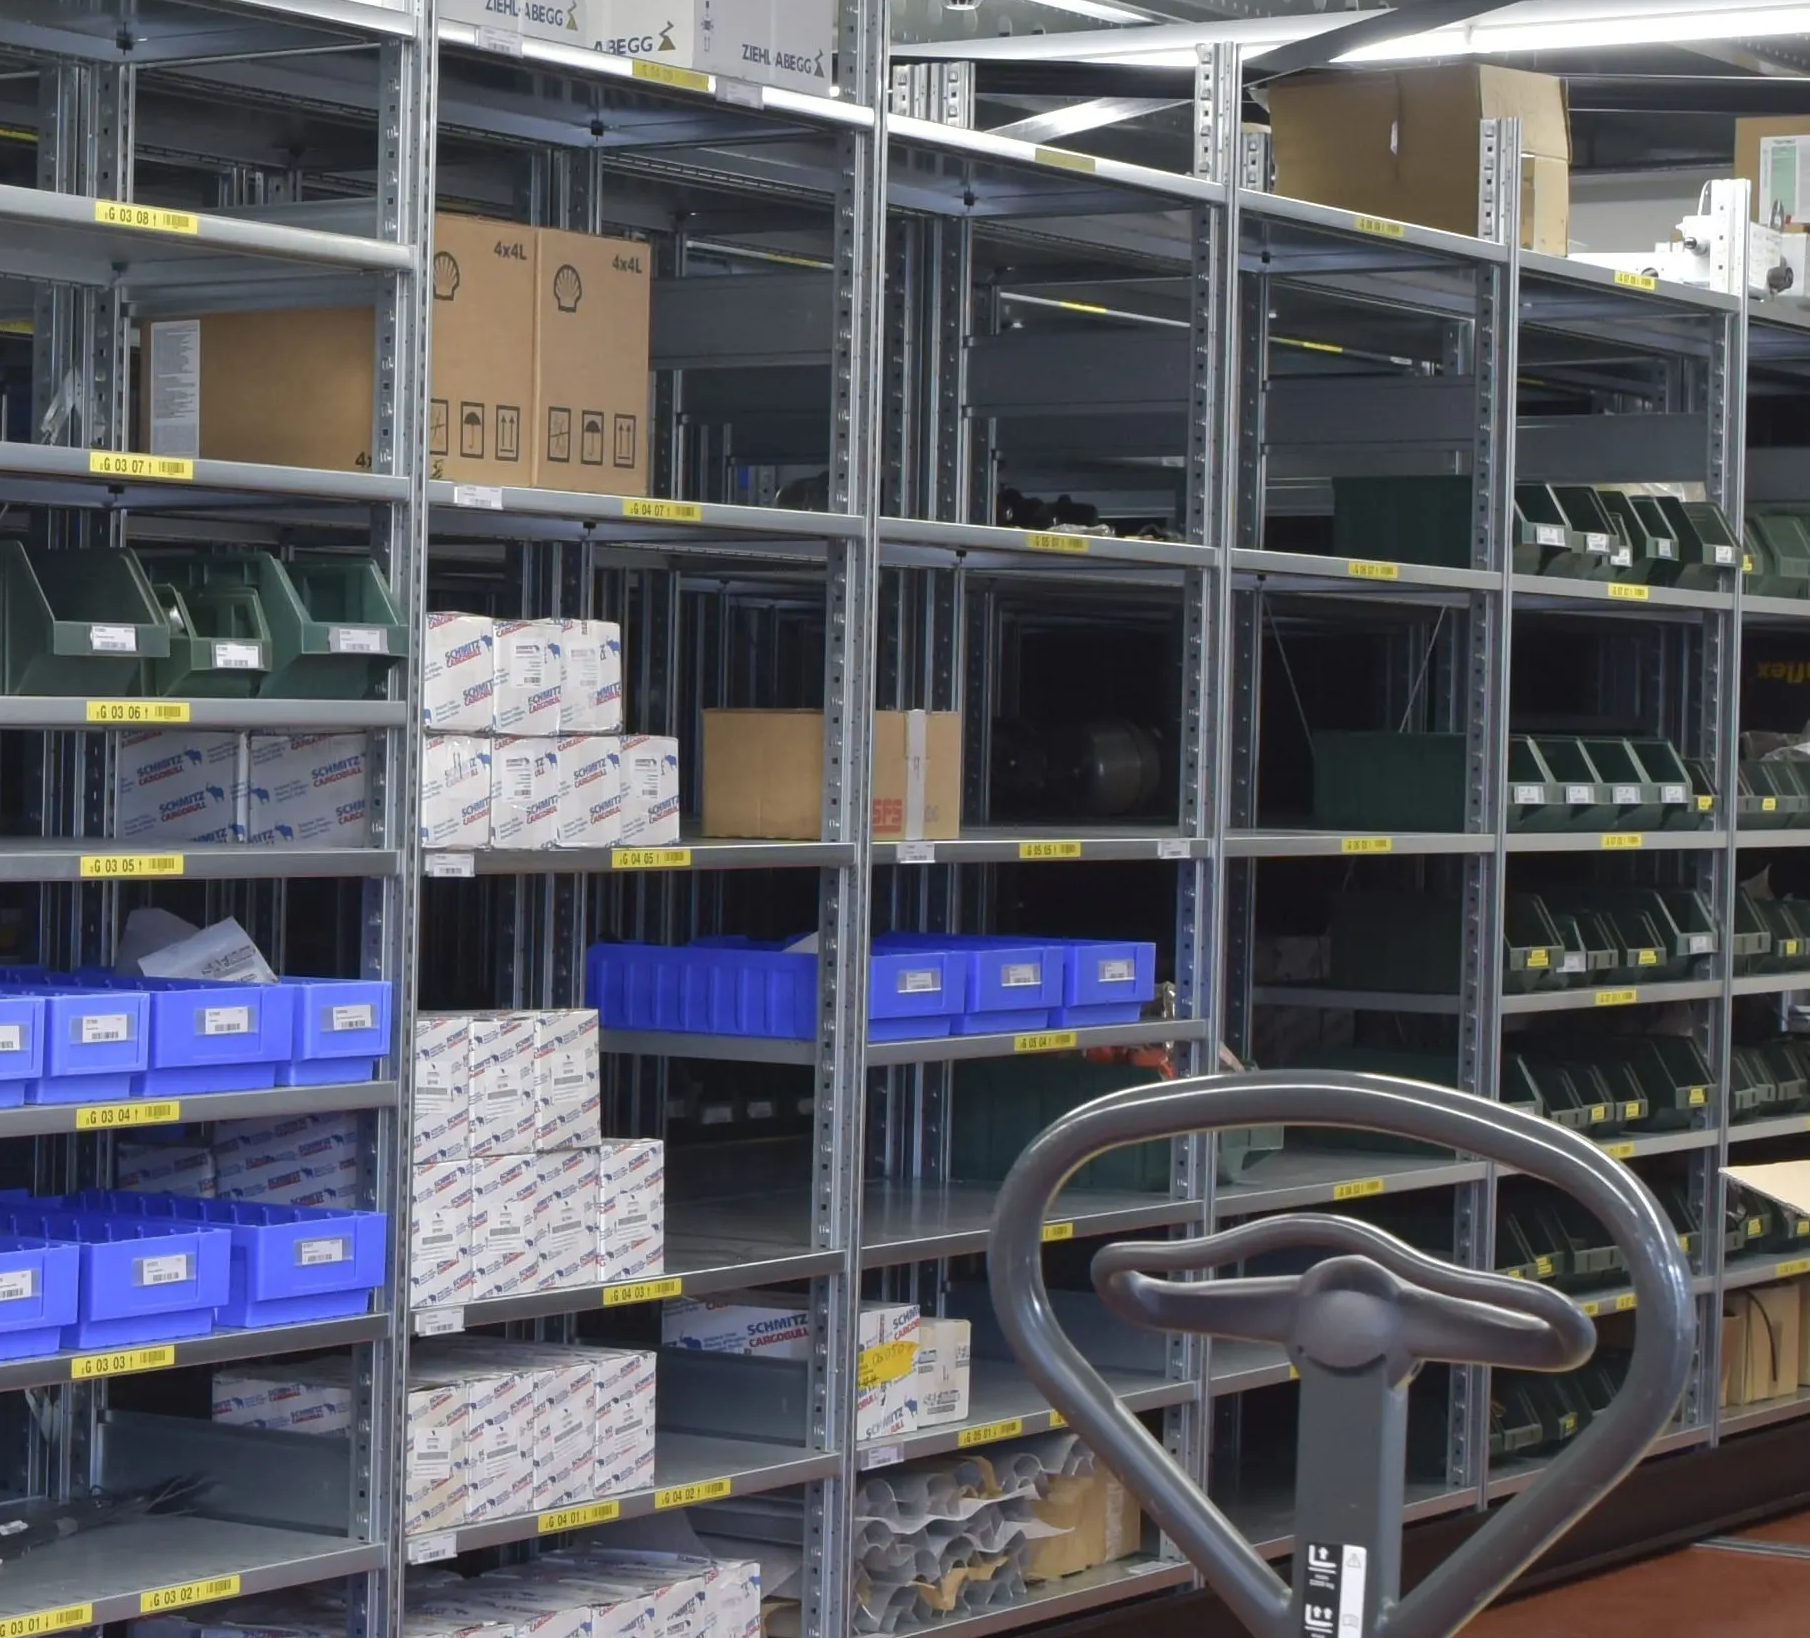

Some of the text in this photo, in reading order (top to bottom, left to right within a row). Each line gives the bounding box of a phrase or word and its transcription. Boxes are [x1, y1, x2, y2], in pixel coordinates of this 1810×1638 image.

[119, 208, 132, 223] 03
[136, 210, 149, 226] 08
[494, 240, 528, 262] 4x4L
[612, 253, 644, 275] 4x4L
[114, 458, 128, 473] 03
[131, 459, 145, 474] 07
[111, 705, 124, 720] 03
[128, 705, 141, 720] 06
[105, 858, 118, 874] 03
[122, 858, 135, 873] 05
[101, 1109, 114, 1124] 03
[117, 1108, 131, 1123] 04
[747, 1313, 810, 1336] SCHMITZ
[748, 1328, 810, 1348] CARGOBULL
[96, 1357, 109, 1373] 03
[112, 1355, 126, 1370] 03
[164, 1589, 177, 1605] 03
[180, 1586, 194, 1602] 02
[10, 1620, 24, 1636] 03
[28, 1617, 40, 1632] 01
